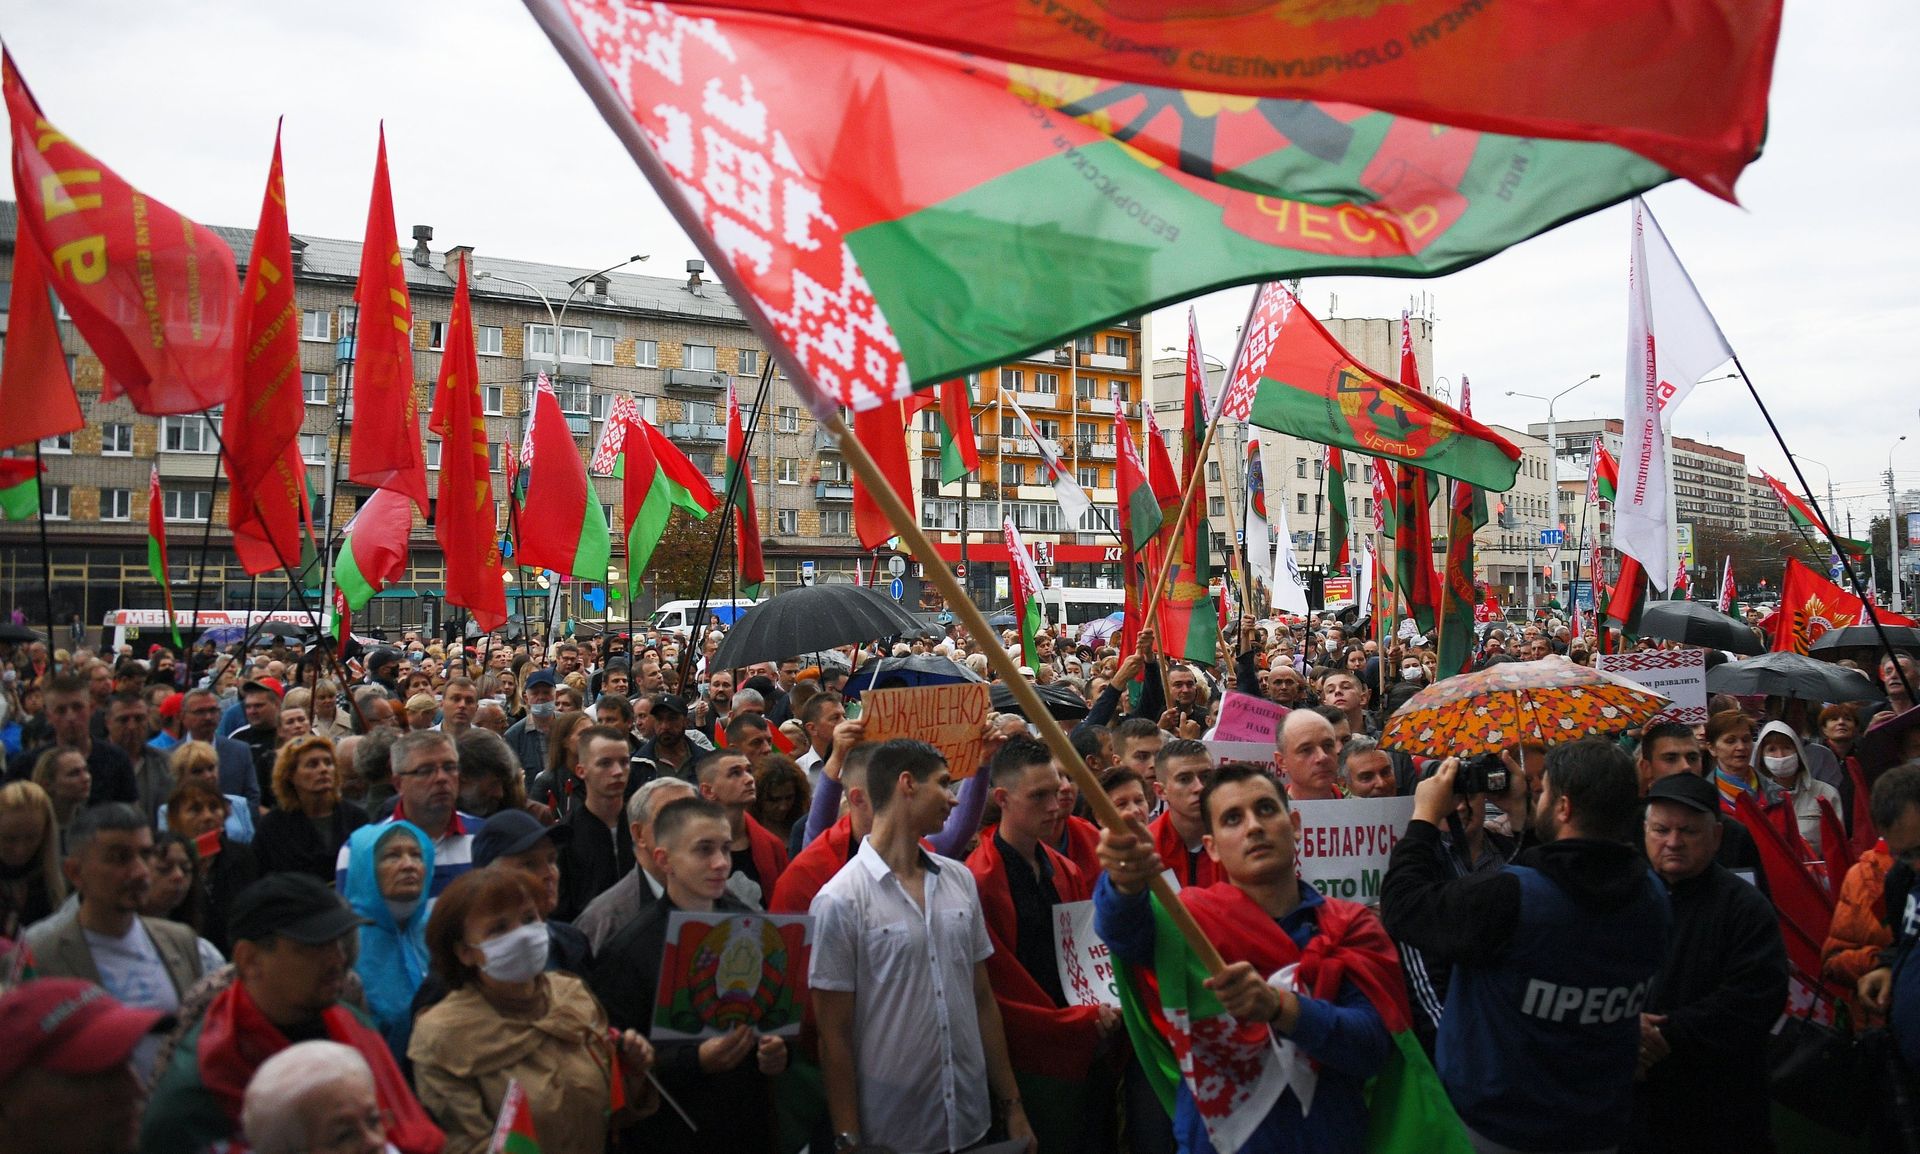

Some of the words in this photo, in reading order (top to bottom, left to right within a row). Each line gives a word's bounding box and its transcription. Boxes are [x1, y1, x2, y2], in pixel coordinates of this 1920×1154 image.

[1364, 430, 1417, 457] ЧЕСТЬ
[1654, 678, 1700, 688] развалить
[1246, 722, 1270, 735] НАШ
